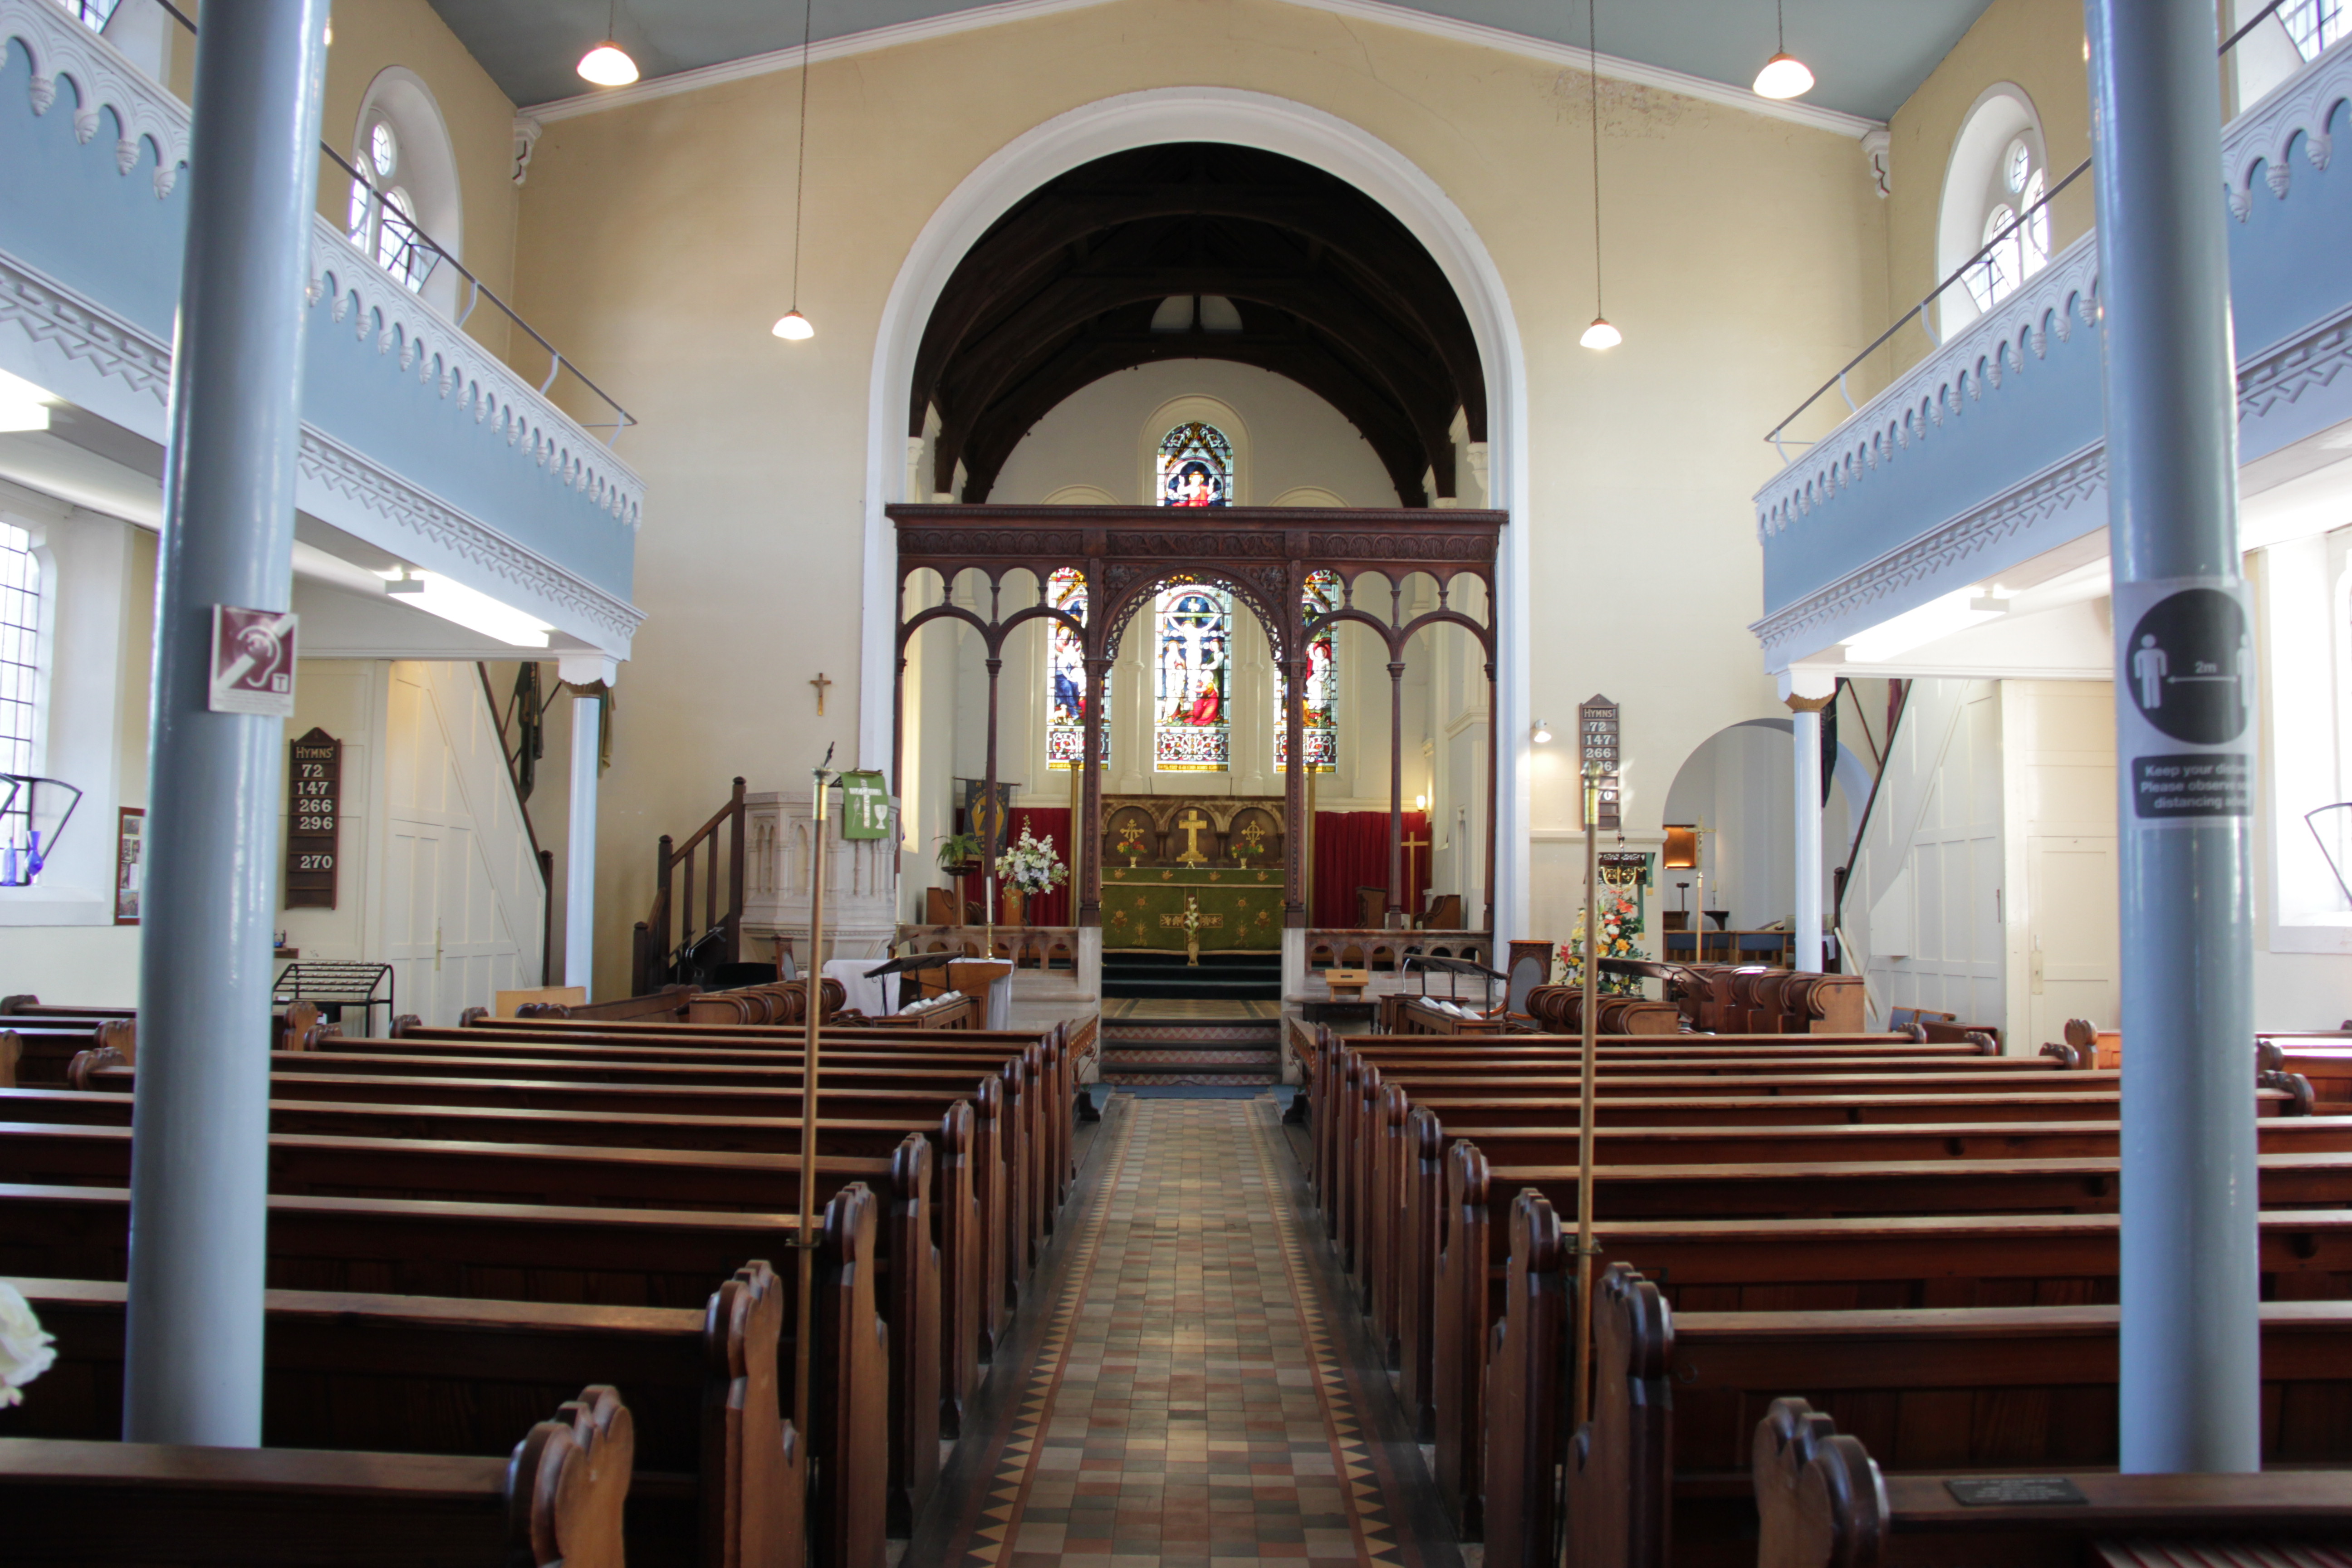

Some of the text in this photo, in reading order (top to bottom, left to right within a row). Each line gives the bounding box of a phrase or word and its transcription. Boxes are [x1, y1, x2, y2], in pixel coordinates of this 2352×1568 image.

[2195, 661, 2217, 674] 2m
[275, 676, 286, 690] T
[1584, 708, 1612, 718] HYMNS
[1589, 721, 1607, 732] 72
[1586, 735, 1611, 745] 147
[296, 746, 333, 759] HYMNS
[1586, 748, 1611, 758] 266
[302, 764, 323, 777] 72
[2145, 765, 2180, 777] Keep
[2183, 764, 2213, 777] your
[298, 781, 329, 794] 147
[2141, 781, 2184, 793] Please
[2188, 779, 2236, 791] observe
[299, 799, 332, 813] 266
[2154, 796, 2223, 809] distancing
[300, 817, 333, 830] 296
[300, 855, 332, 869] 270
